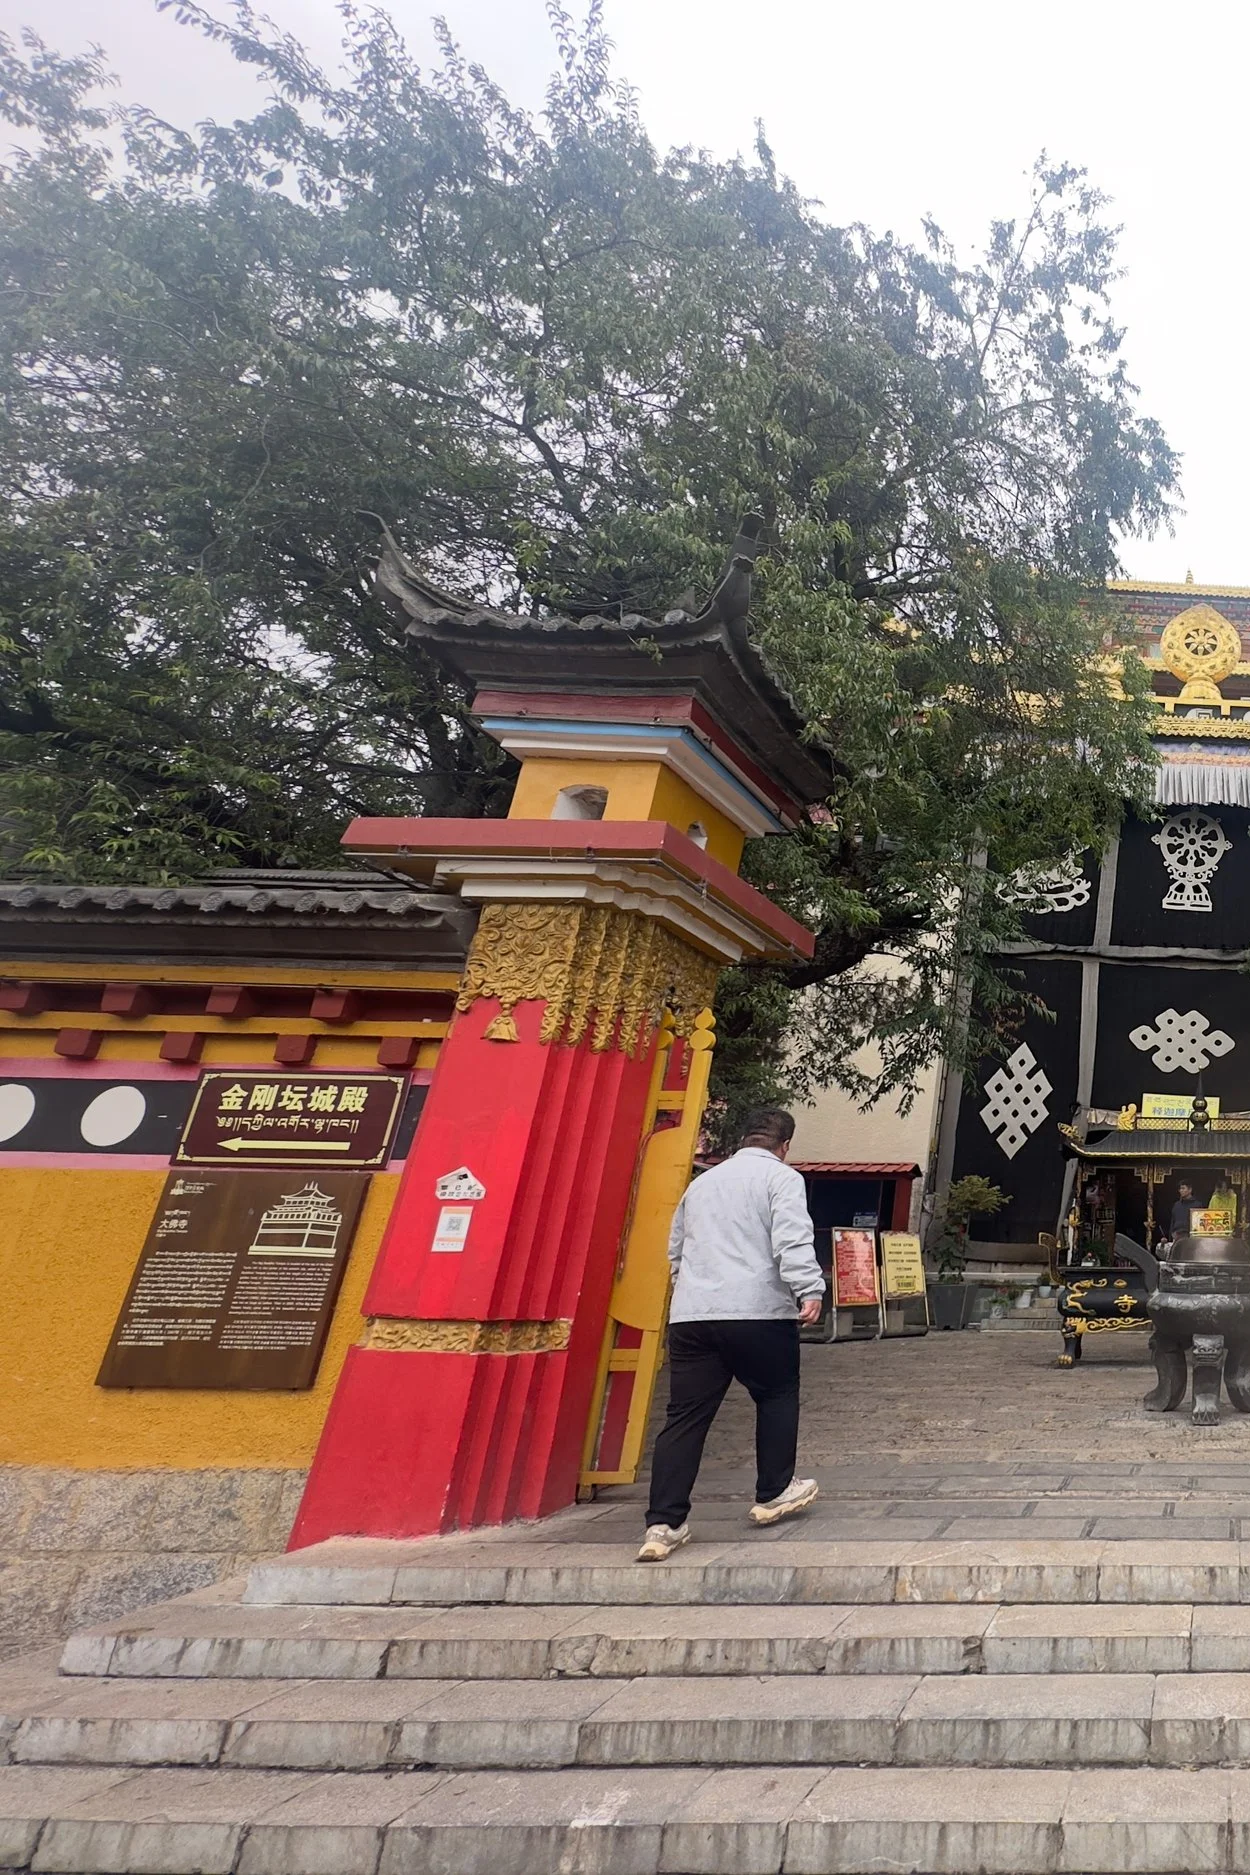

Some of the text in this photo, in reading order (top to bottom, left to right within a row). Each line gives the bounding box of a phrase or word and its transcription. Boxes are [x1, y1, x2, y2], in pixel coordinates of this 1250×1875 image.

[217, 1083, 369, 1113] 金刚坛城殿
[158, 1219, 189, 1229] 大佛寺
[1113, 1294, 1138, 1313] 寺
